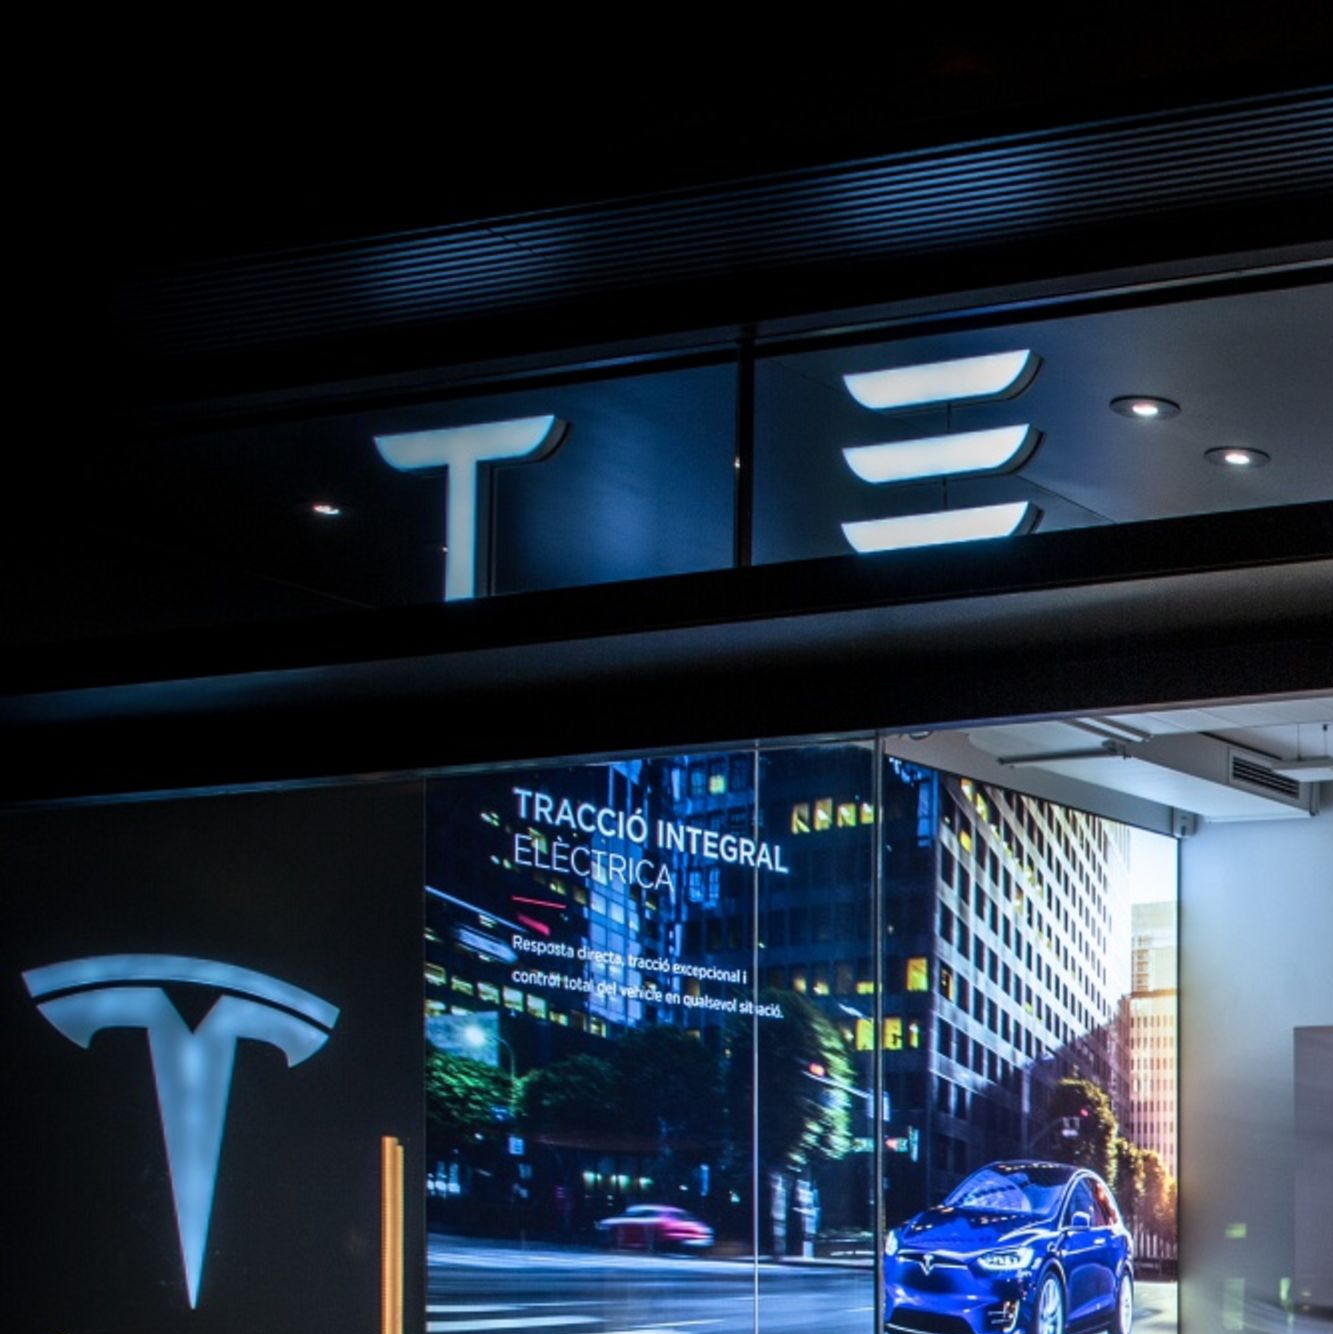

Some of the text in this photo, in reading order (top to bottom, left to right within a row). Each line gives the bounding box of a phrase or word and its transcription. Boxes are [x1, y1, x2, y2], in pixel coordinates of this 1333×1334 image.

[513, 787, 789, 874] TRACCIÓ INTEGRAL
[514, 833, 675, 892] ELÈCTRICA
[512, 935, 747, 985] Resposta directa, tracció excepcional i
[512, 970, 560, 988] control
[564, 976, 594, 992] total
[597, 980, 617, 997] del
[619, 985, 662, 1002] vehicle
[665, 992, 681, 1005] en
[683, 994, 737, 1013] qualsevol
